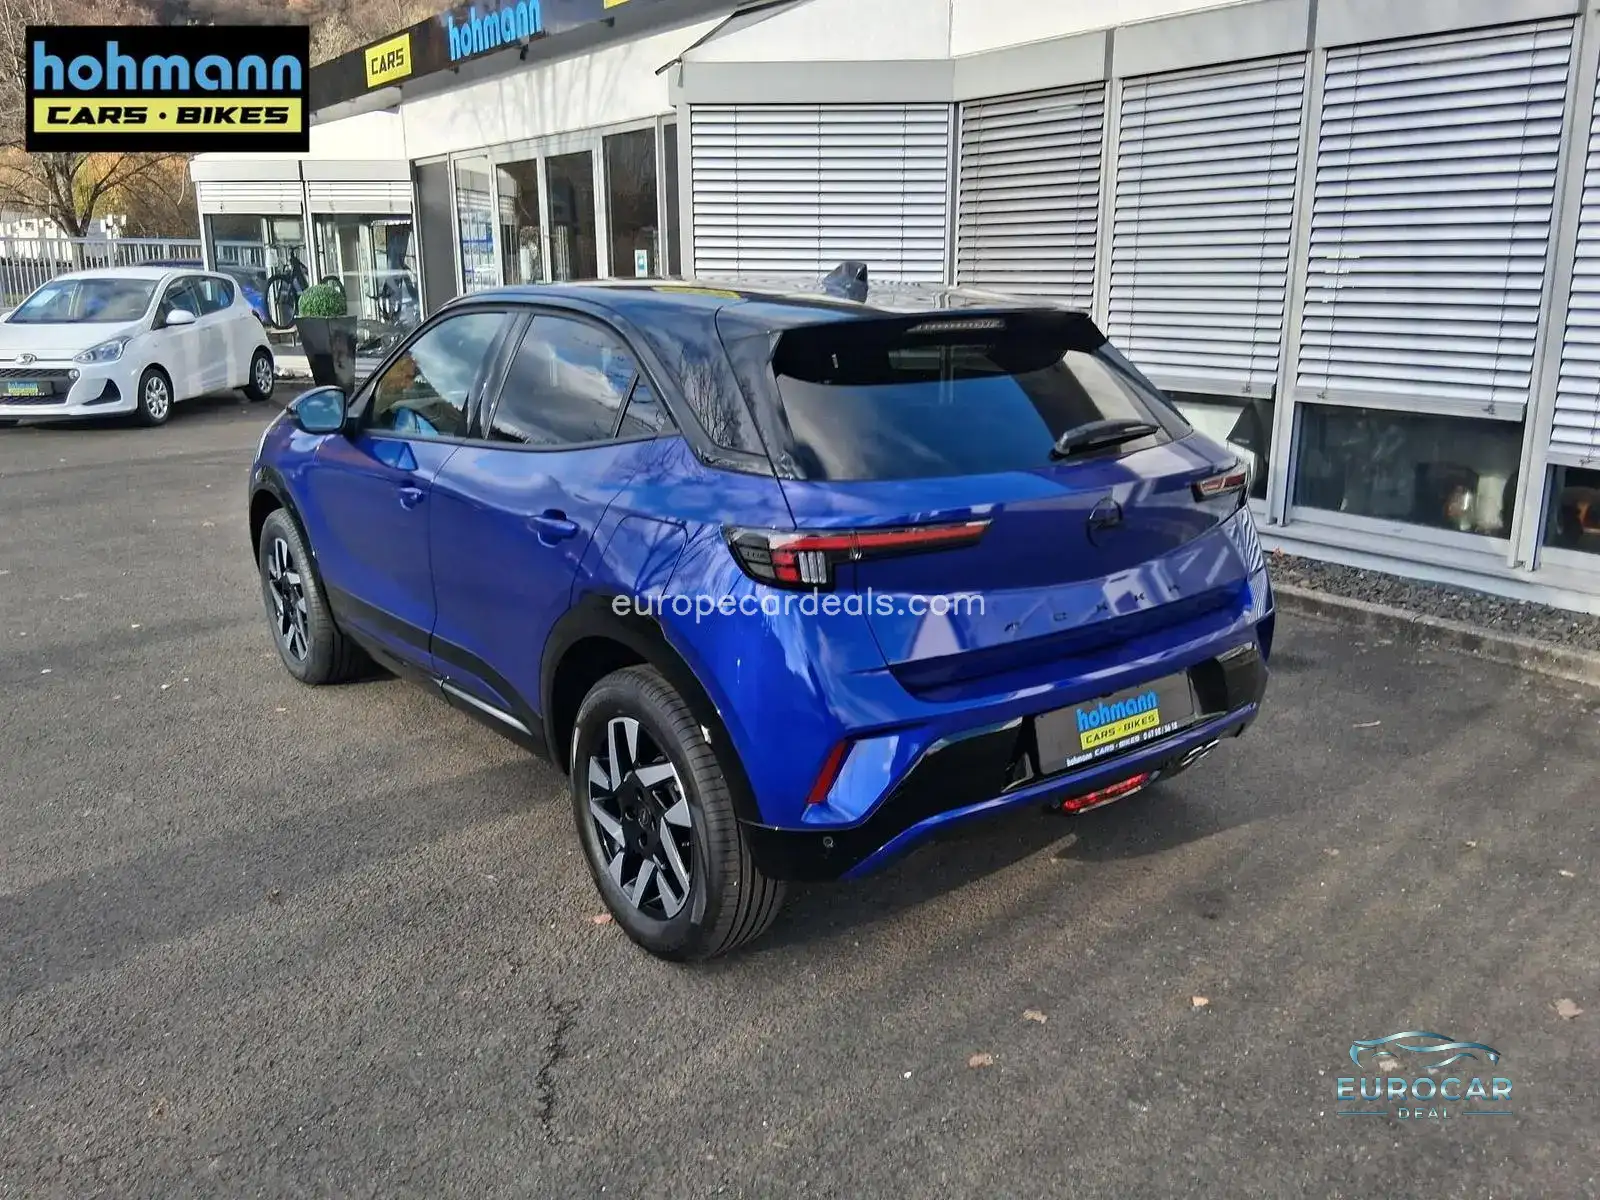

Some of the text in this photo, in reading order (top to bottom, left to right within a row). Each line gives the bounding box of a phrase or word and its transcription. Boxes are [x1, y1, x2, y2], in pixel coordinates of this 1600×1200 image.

[449, 0, 542, 61] hohmann
[371, 47, 404, 75] CARS
[1076, 689, 1158, 732] hohmann
[1086, 727, 1116, 744] CARS
[1124, 714, 1156, 731] BIKES
